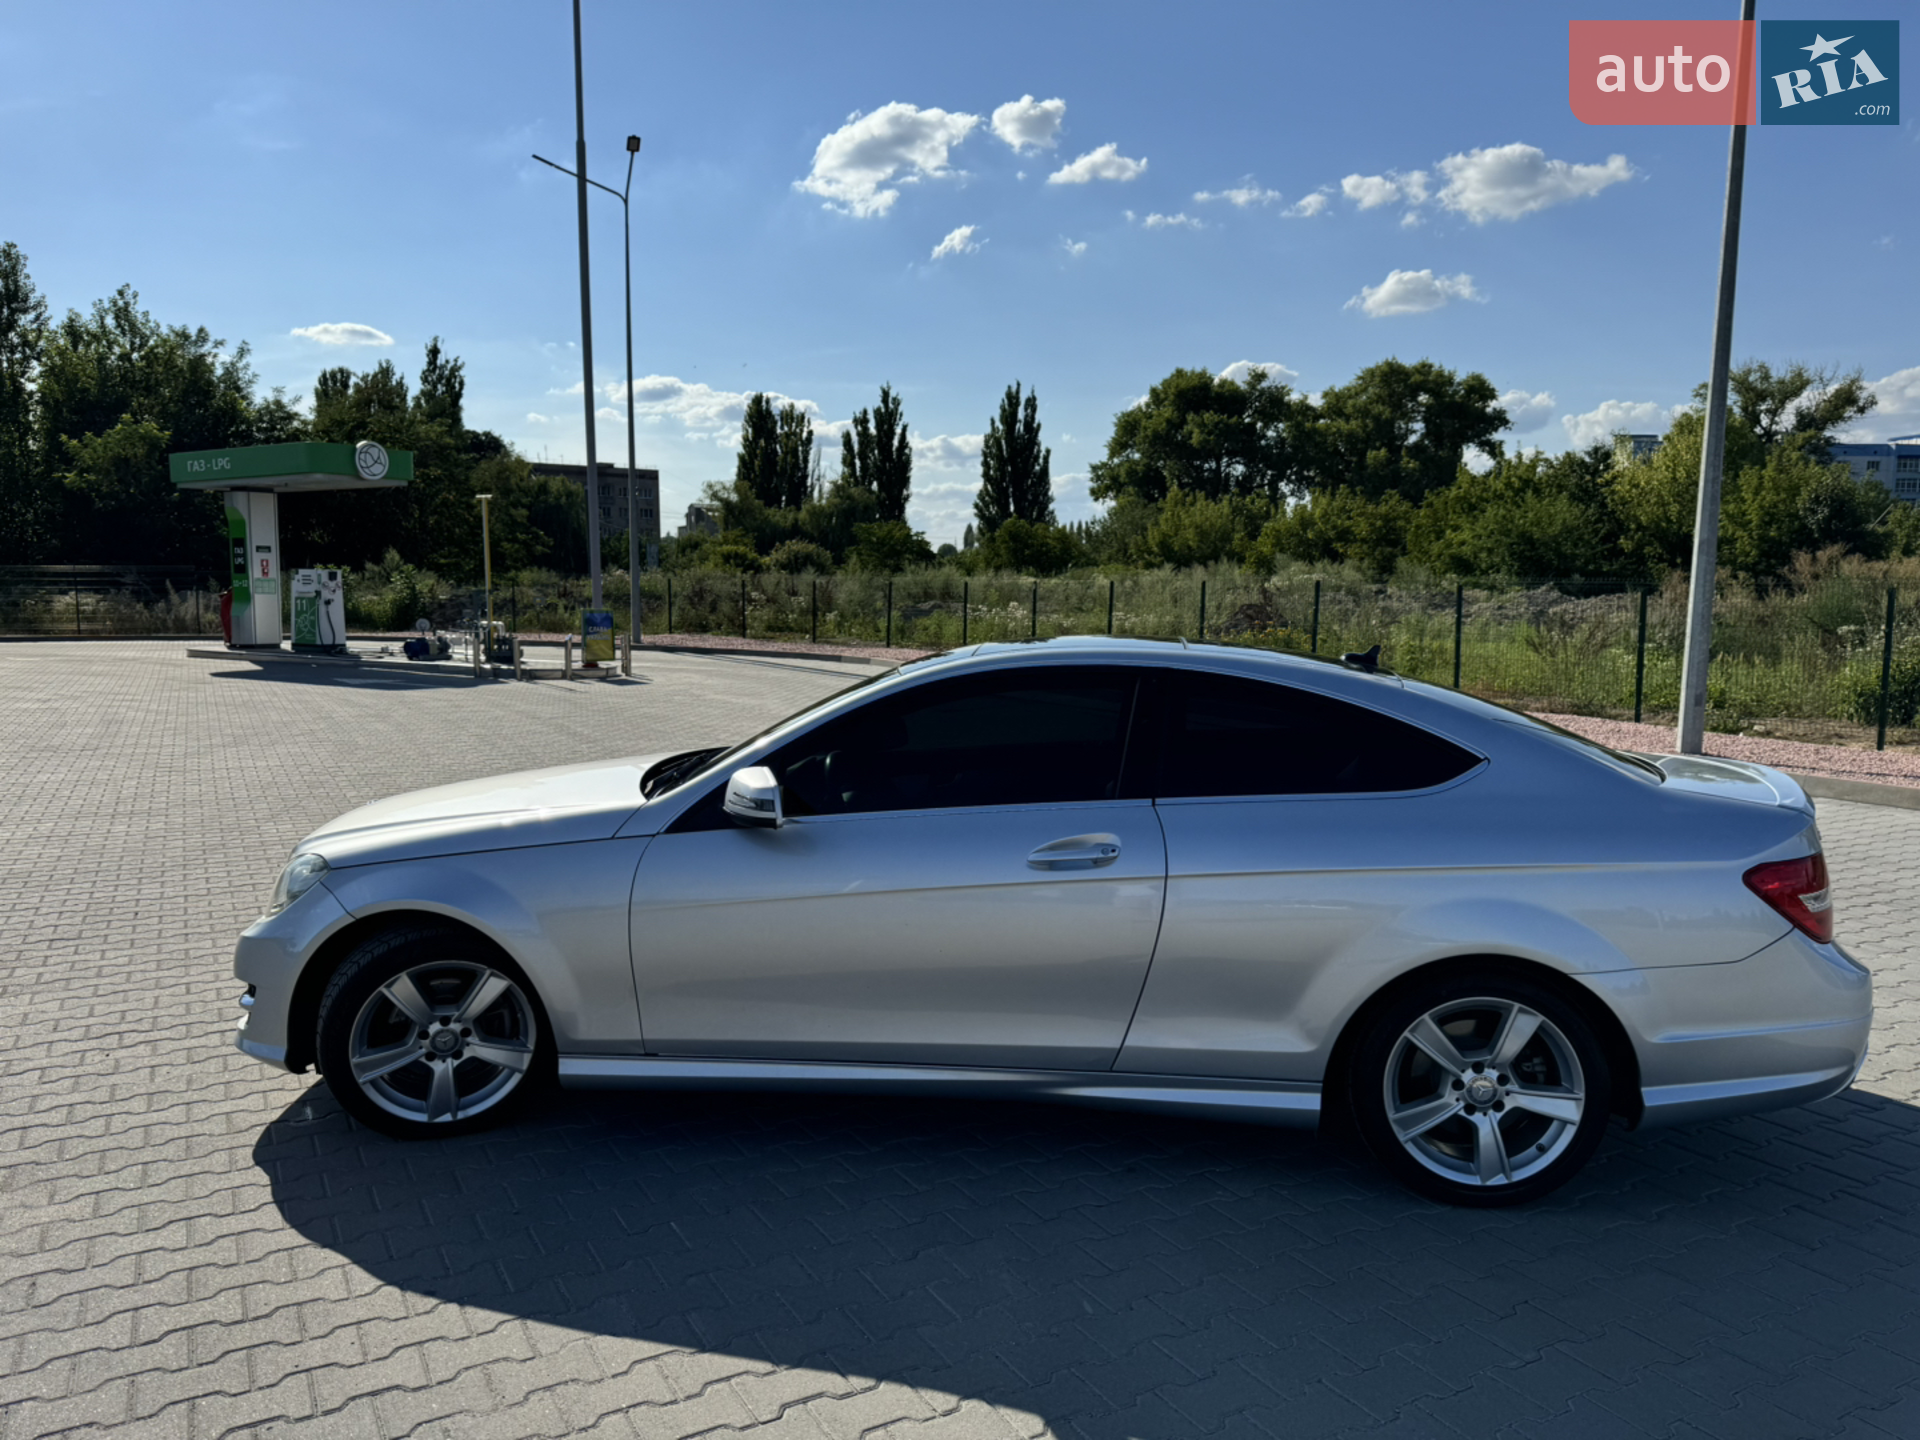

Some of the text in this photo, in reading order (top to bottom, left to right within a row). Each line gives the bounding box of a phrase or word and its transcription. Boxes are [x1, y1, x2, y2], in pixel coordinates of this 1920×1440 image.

[187, 459, 206, 472] ГАЗ
[212, 457, 231, 470] LPG
[296, 599, 307, 611] 11
